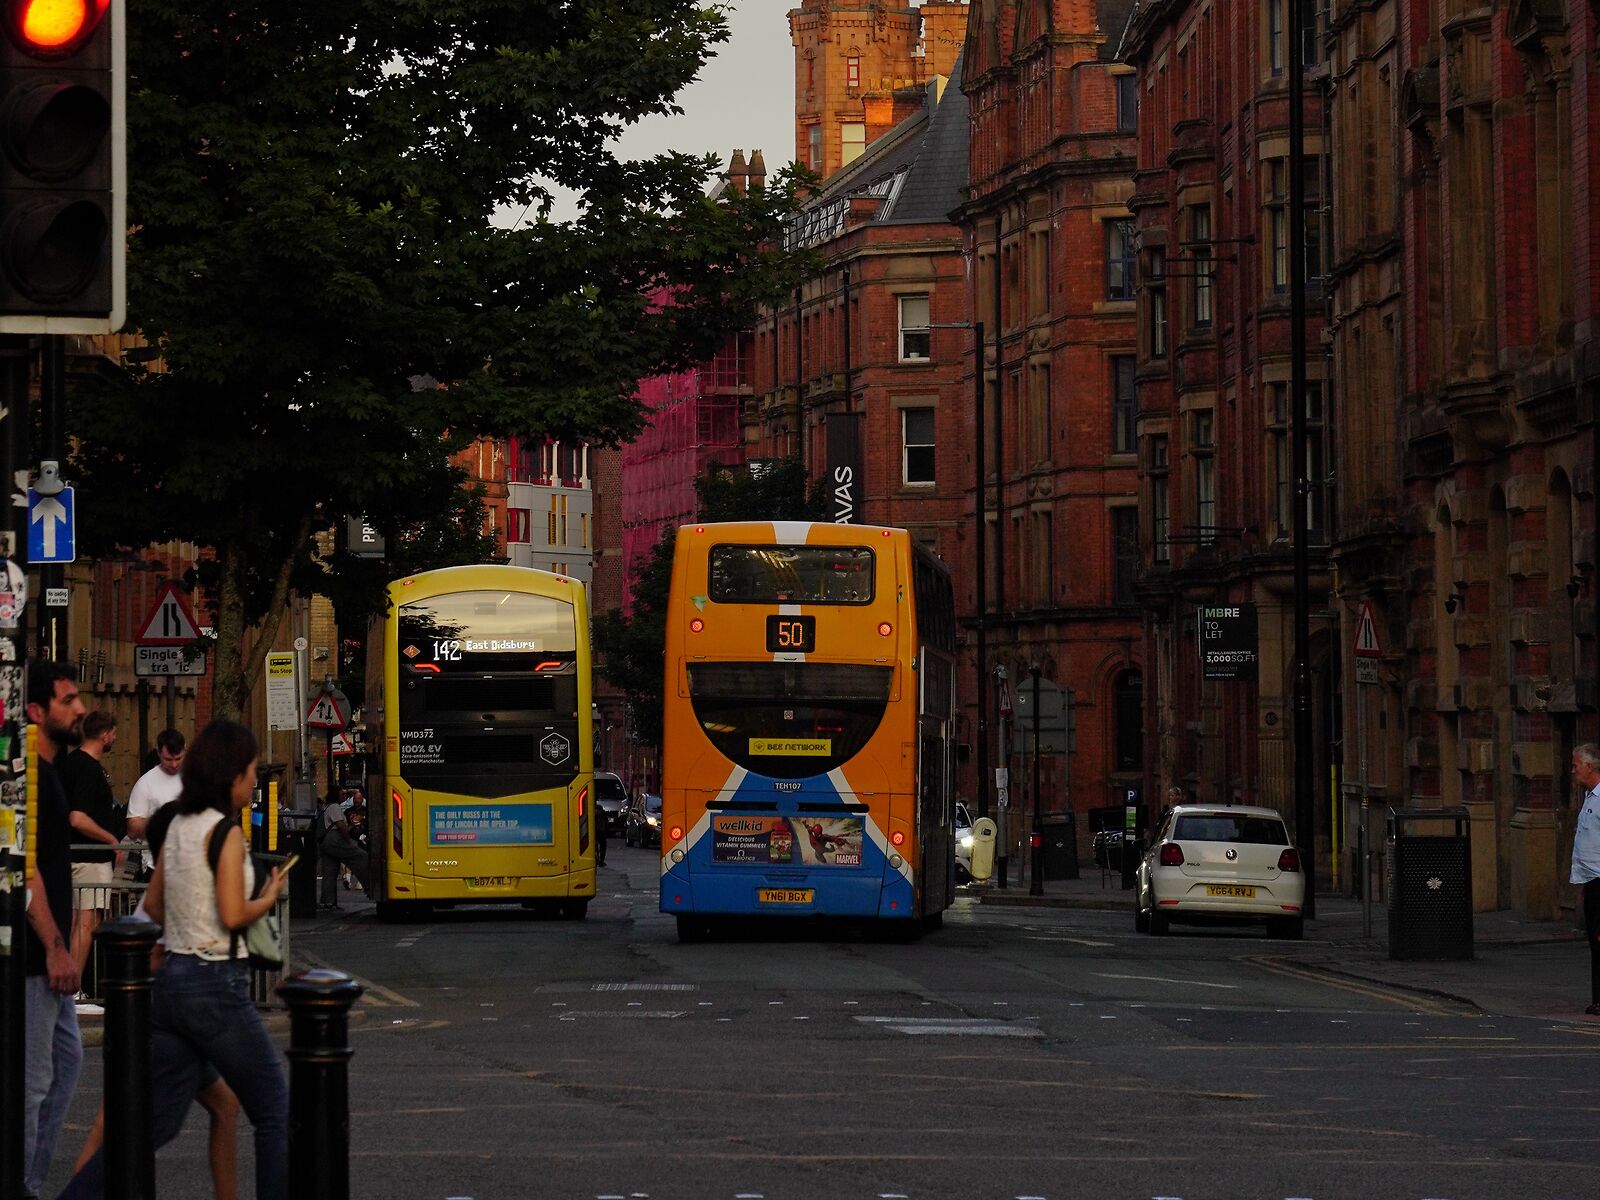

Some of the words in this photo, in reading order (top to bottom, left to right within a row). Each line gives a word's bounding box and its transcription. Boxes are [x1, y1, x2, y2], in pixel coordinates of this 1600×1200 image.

[1205, 608, 1240, 618] MBRE
[1205, 621, 1219, 630] TO
[778, 622, 803, 646] 50
[1205, 630, 1223, 639] LET
[140, 649, 177, 661] Single
[433, 640, 462, 661] 142
[466, 640, 488, 650] East
[491, 640, 535, 651] Didsbury
[151, 663, 190, 673] traic
[401, 731, 434, 739] VMD372
[401, 744, 425, 754] 100%
[767, 743, 783, 751] BEE
[784, 743, 826, 751] NETWORK
[775, 782, 801, 790] TEH107
[1127, 790, 1135, 801] P
[719, 820, 763, 831] wellkid
[836, 854, 859, 865] MARVEL
[765, 891, 786, 901] YN61
[788, 891, 806, 901] BGX
[1210, 887, 1232, 896] YG64
[1235, 888, 1252, 897] RVJ
